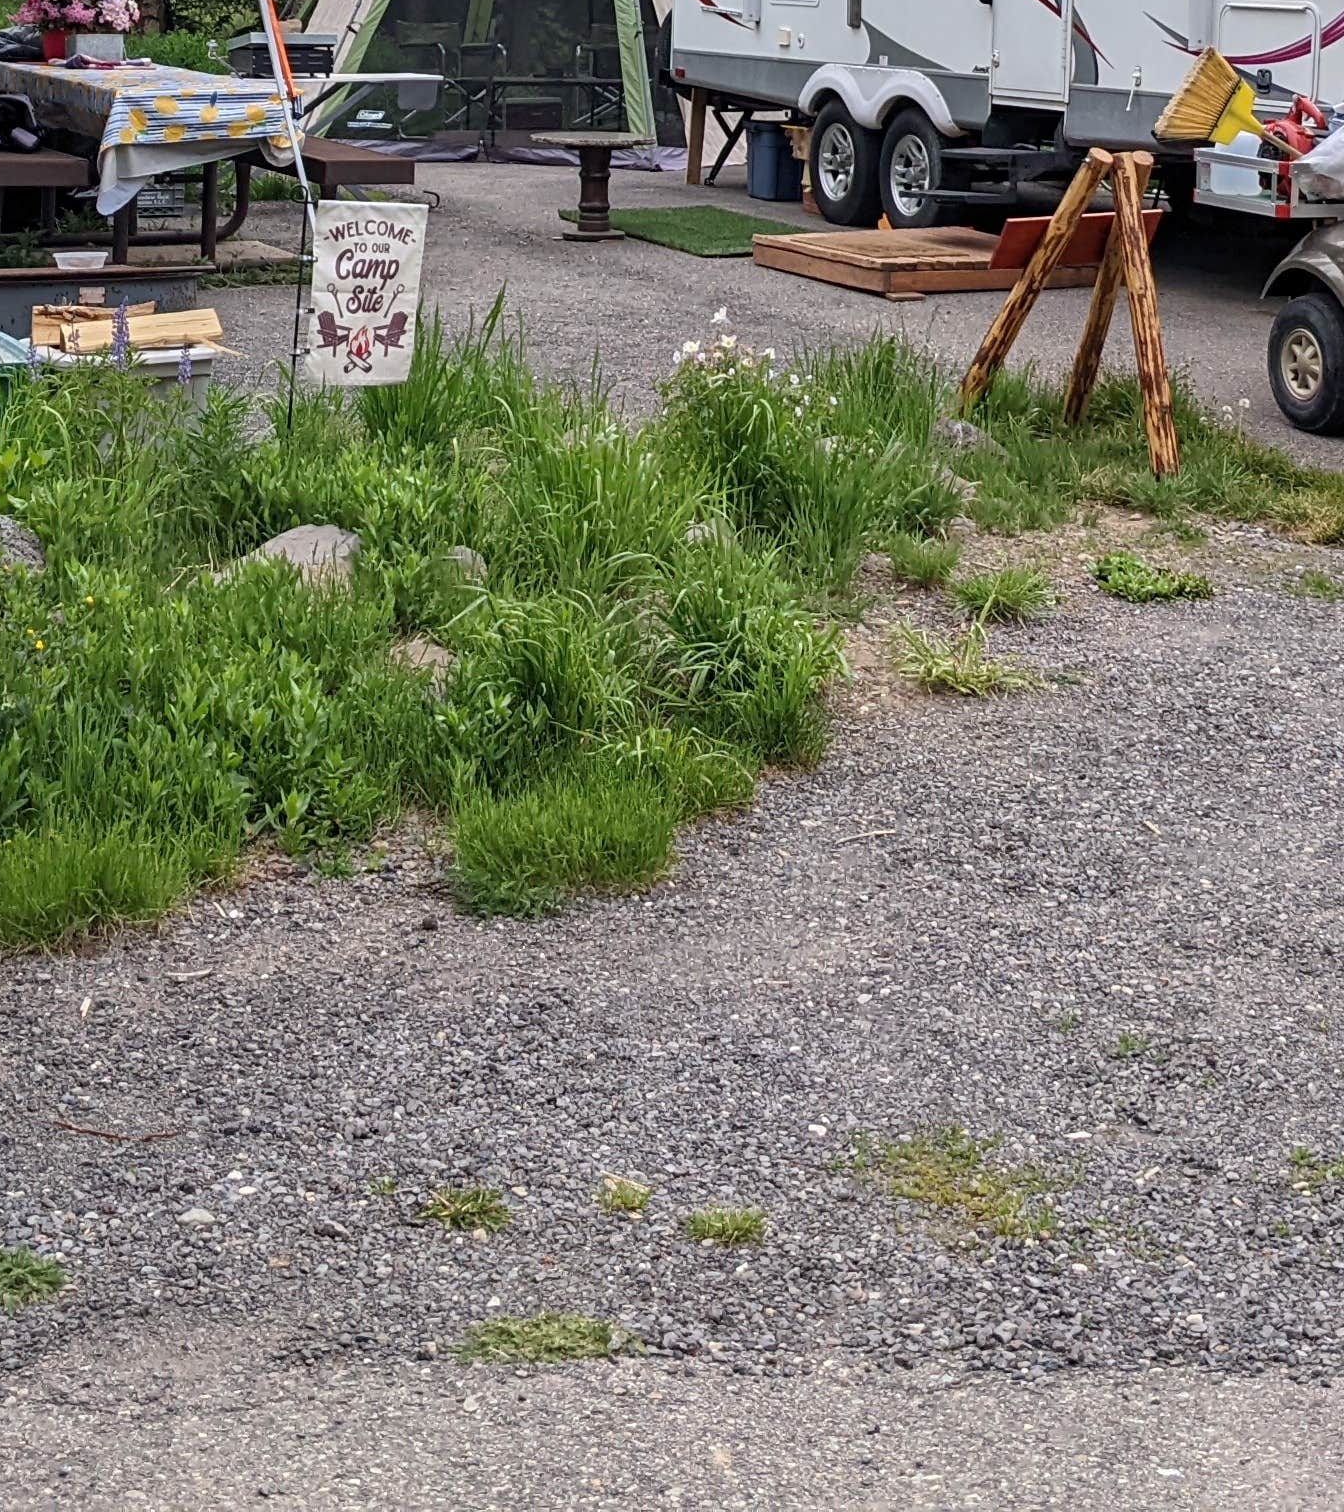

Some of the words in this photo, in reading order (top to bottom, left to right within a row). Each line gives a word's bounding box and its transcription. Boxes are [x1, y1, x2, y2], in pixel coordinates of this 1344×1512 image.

[354, 243, 368, 253] TO
[372, 243, 390, 253] OUR
[335, 248, 400, 291] Camp
[346, 285, 384, 314] Site
